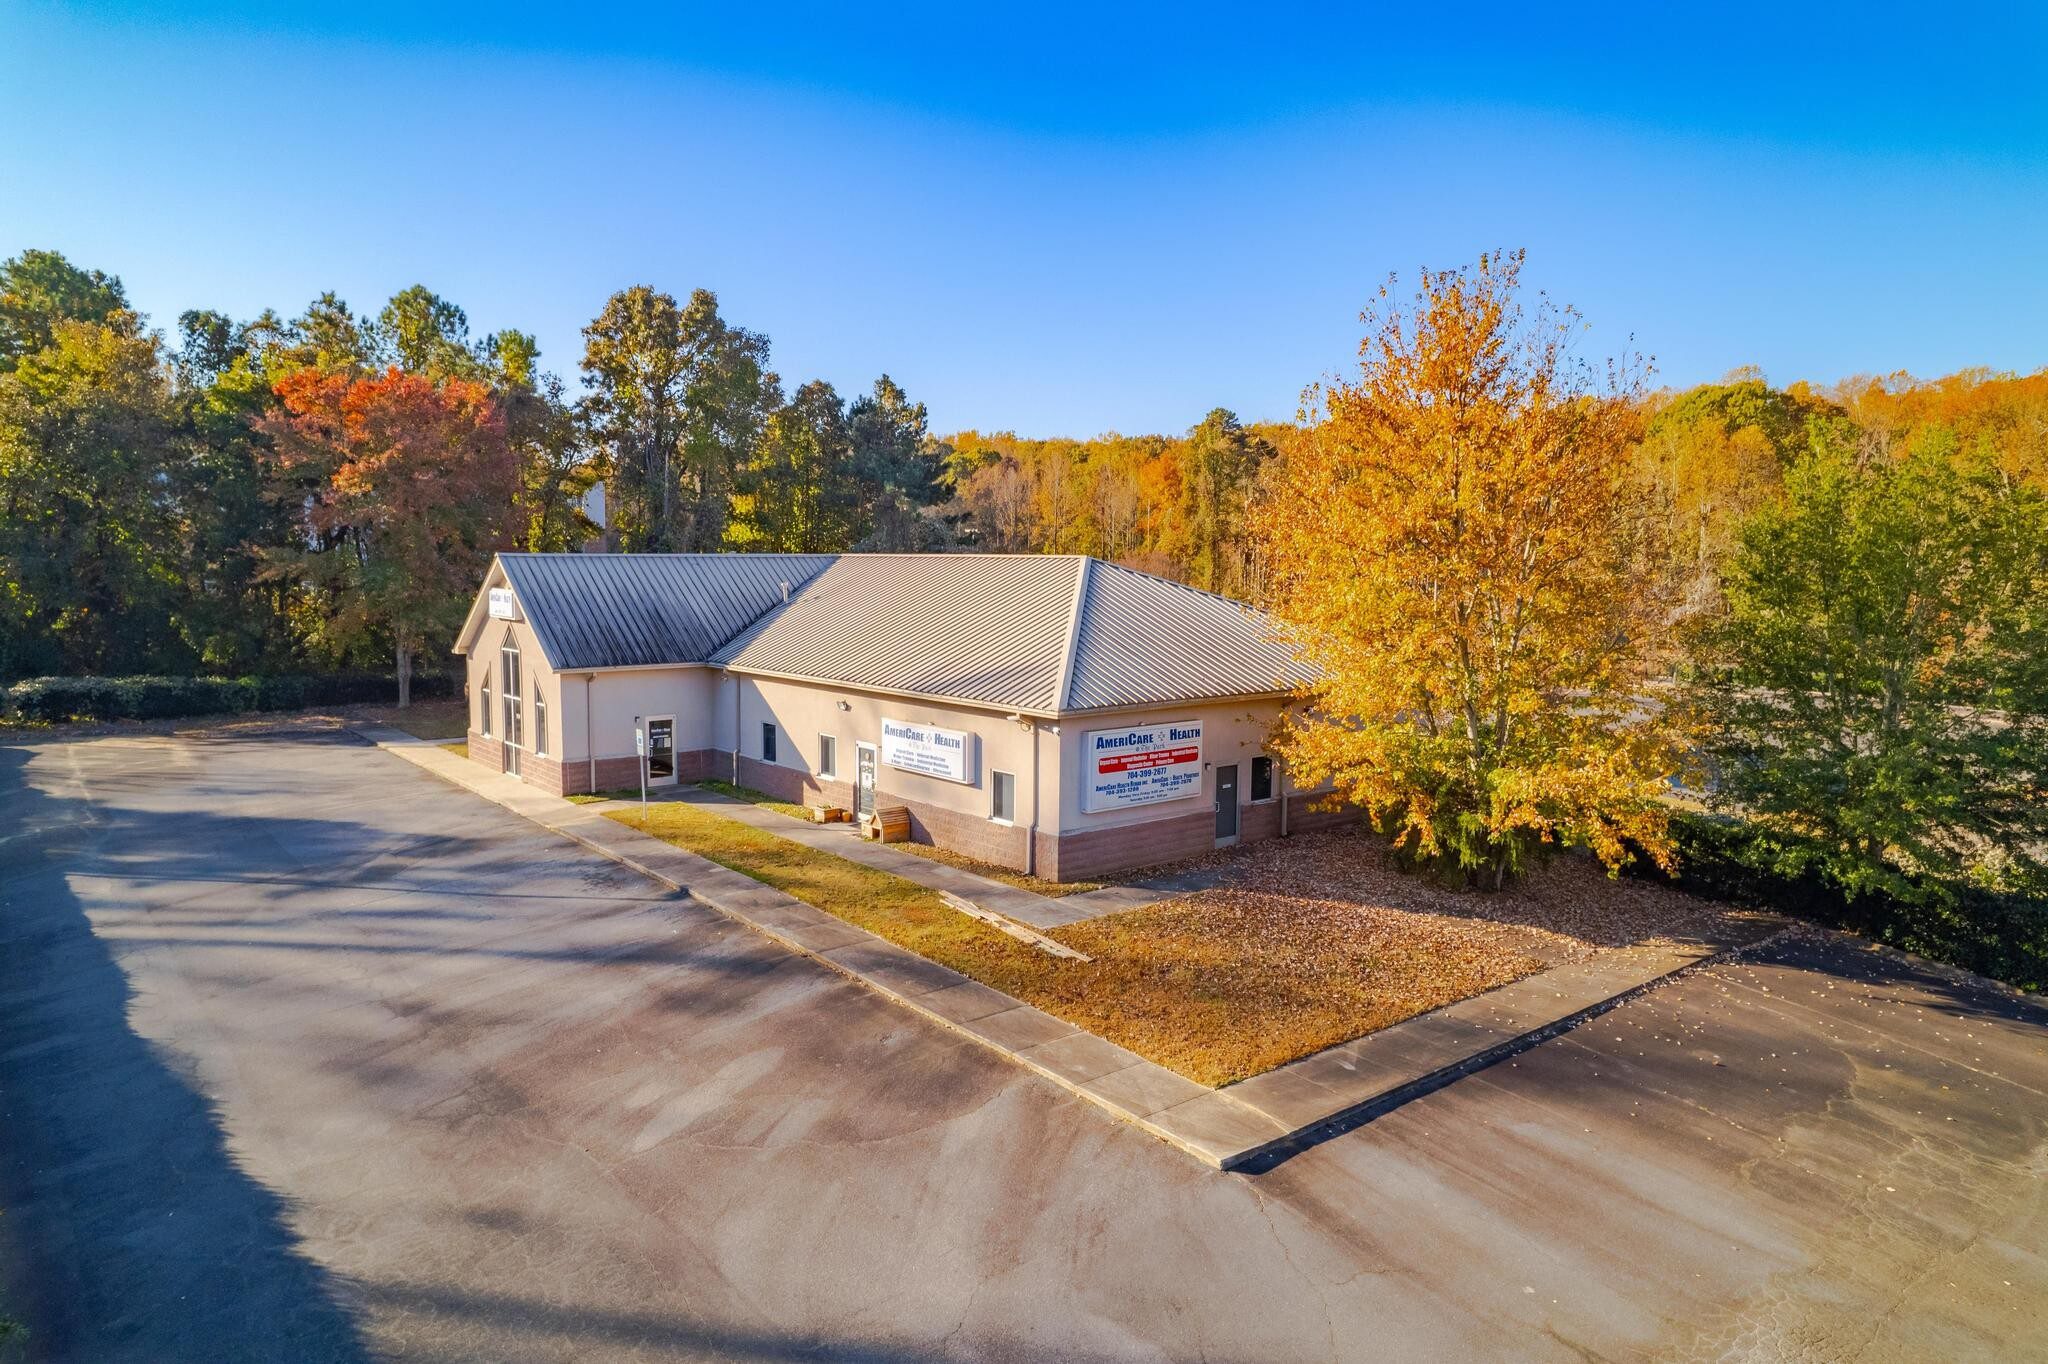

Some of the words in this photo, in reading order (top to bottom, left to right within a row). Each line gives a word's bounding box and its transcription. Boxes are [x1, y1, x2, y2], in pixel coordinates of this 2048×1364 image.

[934, 733, 960, 749] HEALTH
[1096, 733, 1154, 749] AMERICARE
[1169, 728, 1200, 741] HEALTH
